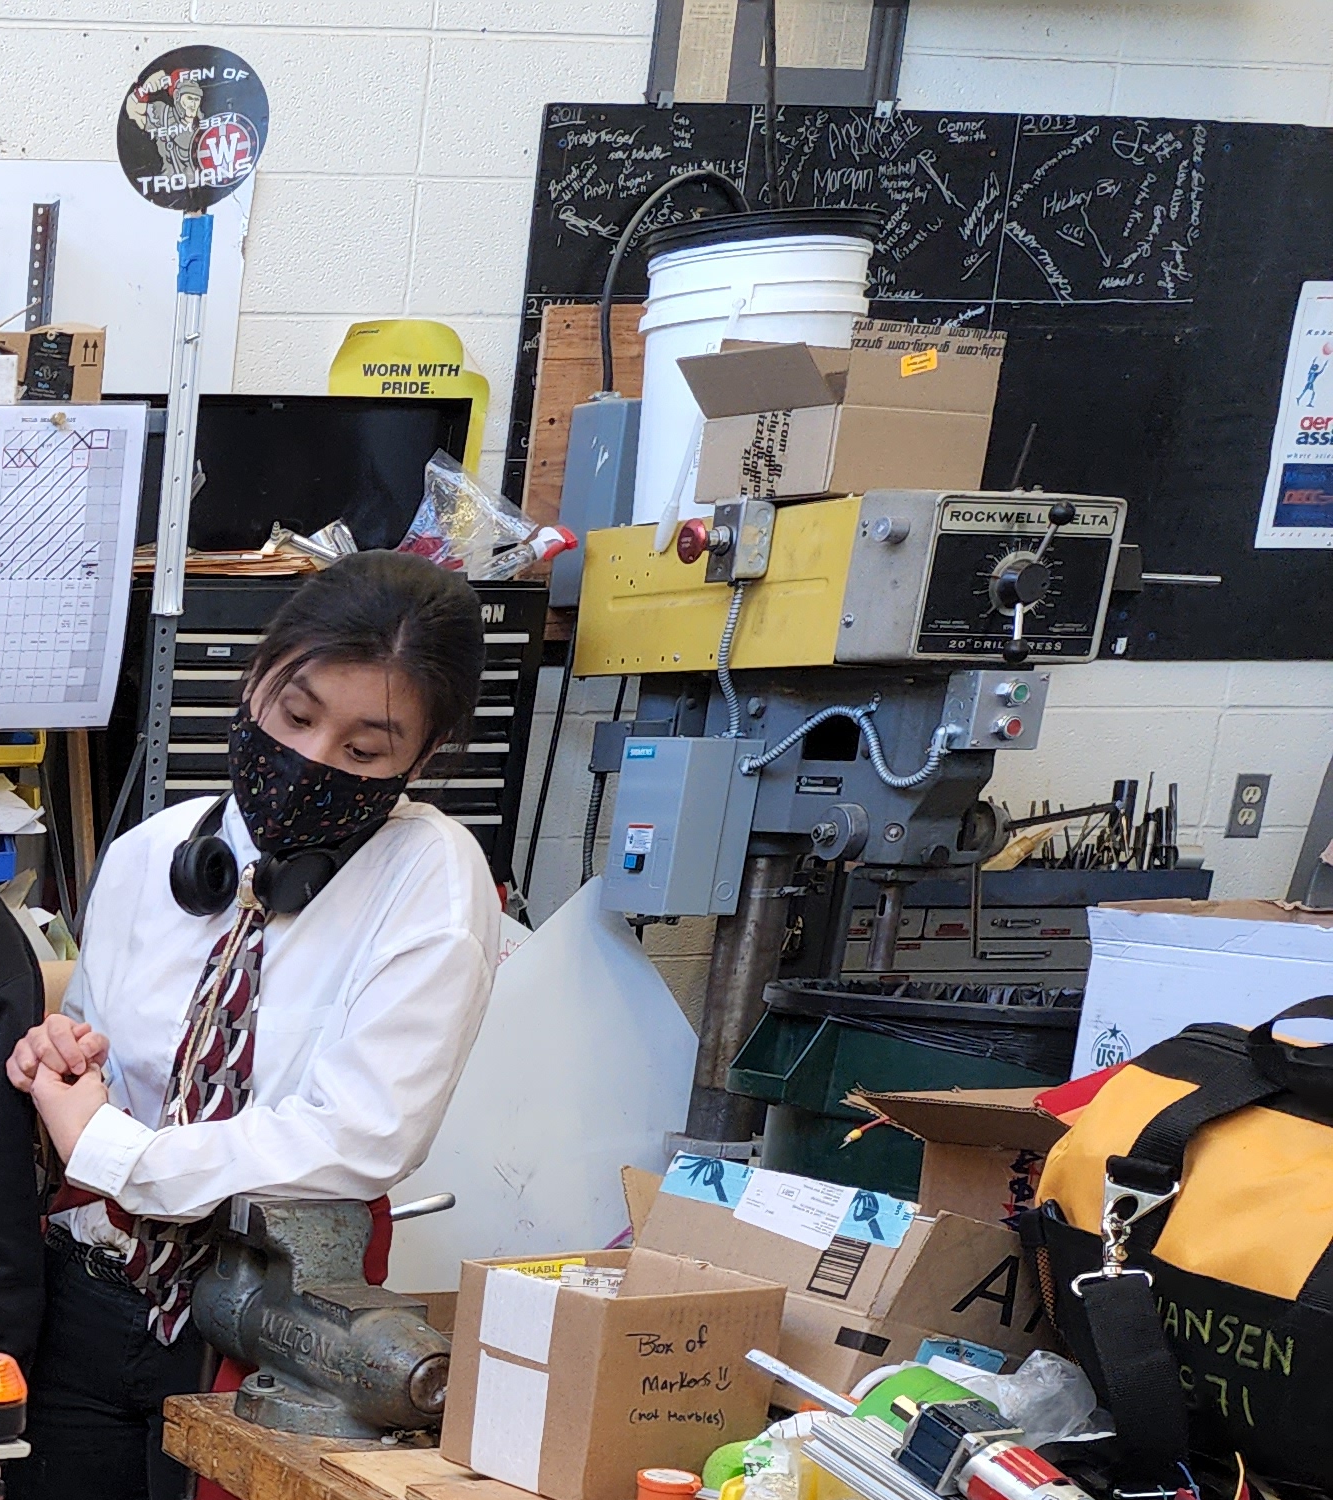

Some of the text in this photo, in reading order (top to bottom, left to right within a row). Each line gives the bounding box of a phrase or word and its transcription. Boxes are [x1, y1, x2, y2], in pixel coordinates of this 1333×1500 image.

[160, 66, 250, 89] A FAN OF
[148, 113, 238, 141] TEAM 3871
[938, 117, 985, 134] Connor
[1023, 115, 1076, 131] 2013
[948, 131, 987, 143] Smith
[206, 132, 241, 167] W
[137, 156, 254, 196] TROJANS
[813, 166, 874, 202] Morgan
[362, 363, 461, 377] WORN WITH
[381, 381, 436, 395] PRIDE.
[949, 509, 1109, 527] ROCKWELL ELTA
[974, 640, 1008, 650] DRIL
[1029, 640, 1063, 651] RESS
[1095, 1047, 1124, 1067] USA
[625, 1324, 709, 1357] Box of
[1155, 1296, 1297, 1377] ANSEN
[641, 1370, 713, 1396] Markers
[629, 1408, 659, 1425] (not
